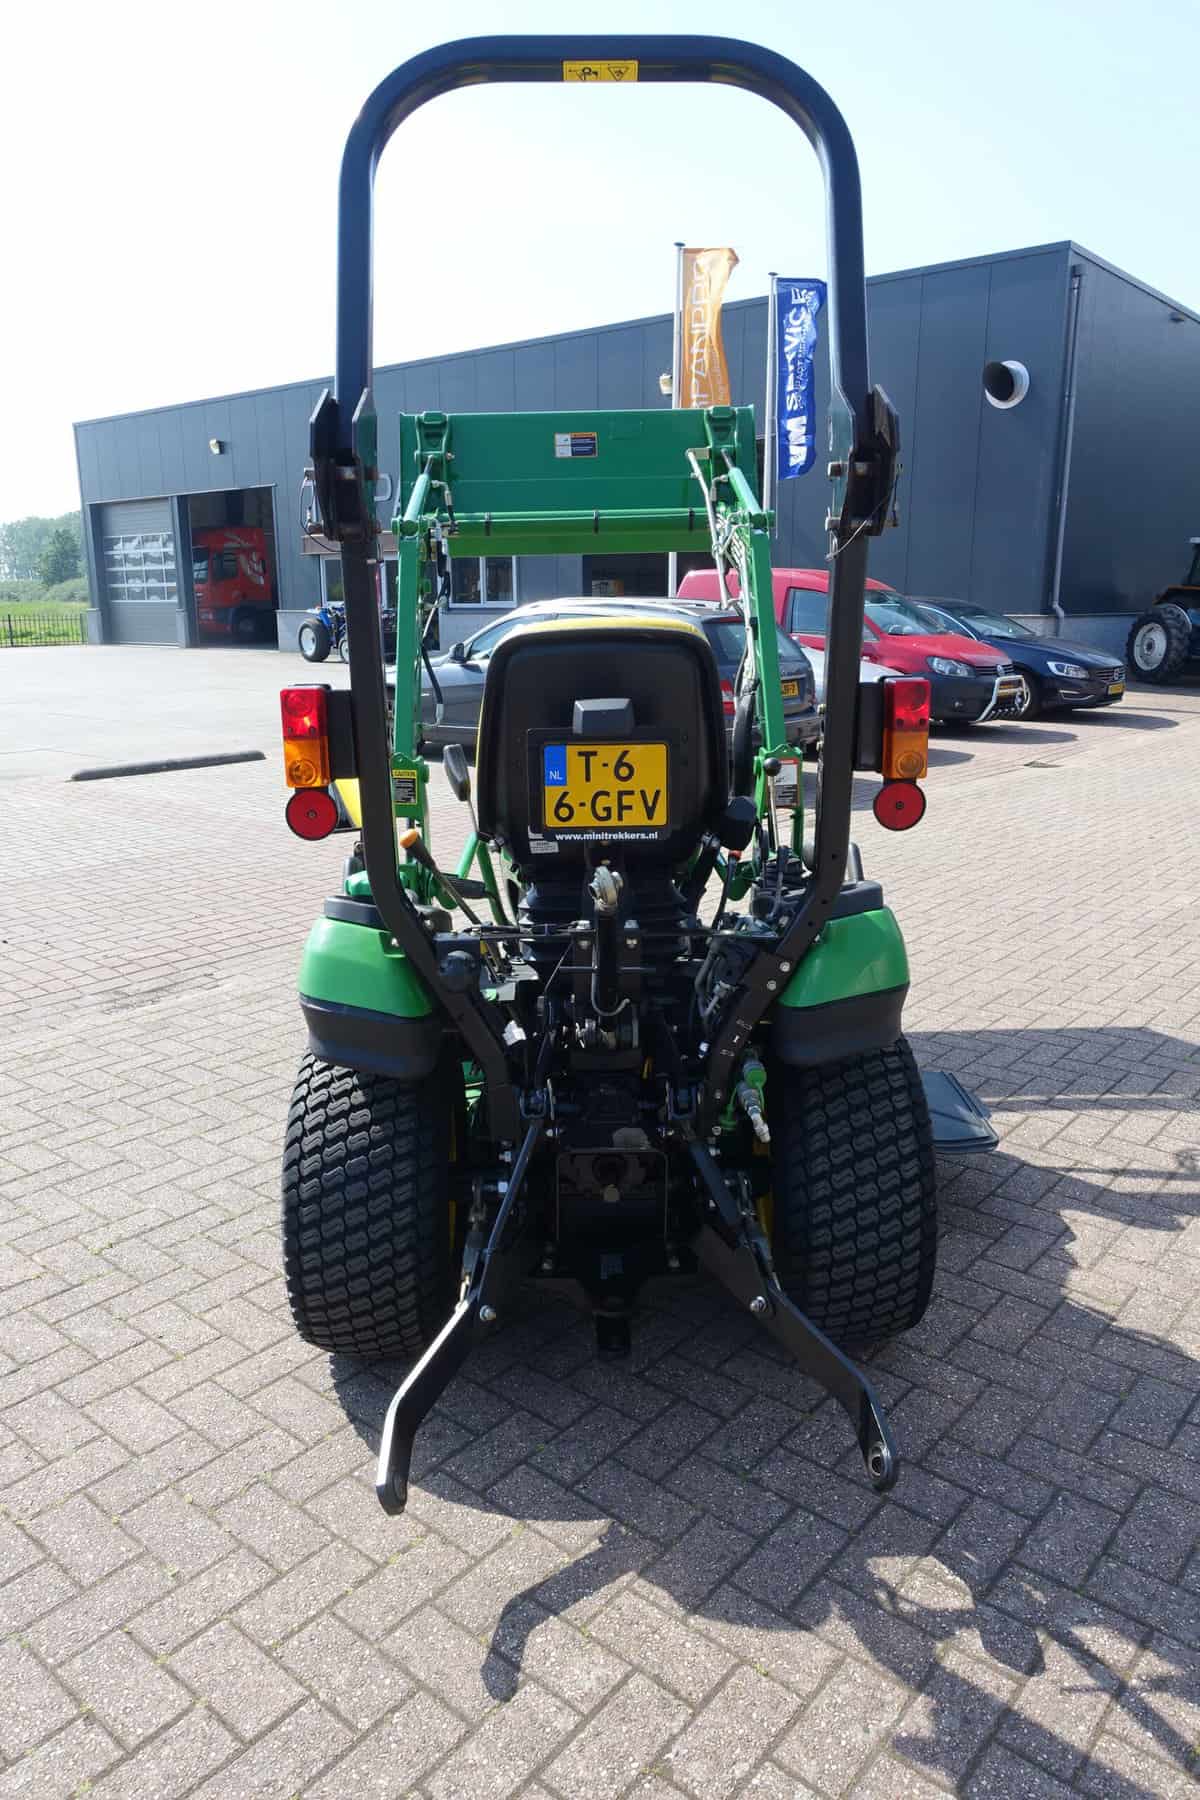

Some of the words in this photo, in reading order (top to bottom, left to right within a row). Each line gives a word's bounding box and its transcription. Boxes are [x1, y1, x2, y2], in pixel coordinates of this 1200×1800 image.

[549, 770, 563, 780] NL
[577, 750, 635, 782] T-6
[554, 789, 661, 822] 6-GFV
[555, 831, 658, 841] www.minitrekkers.nl
